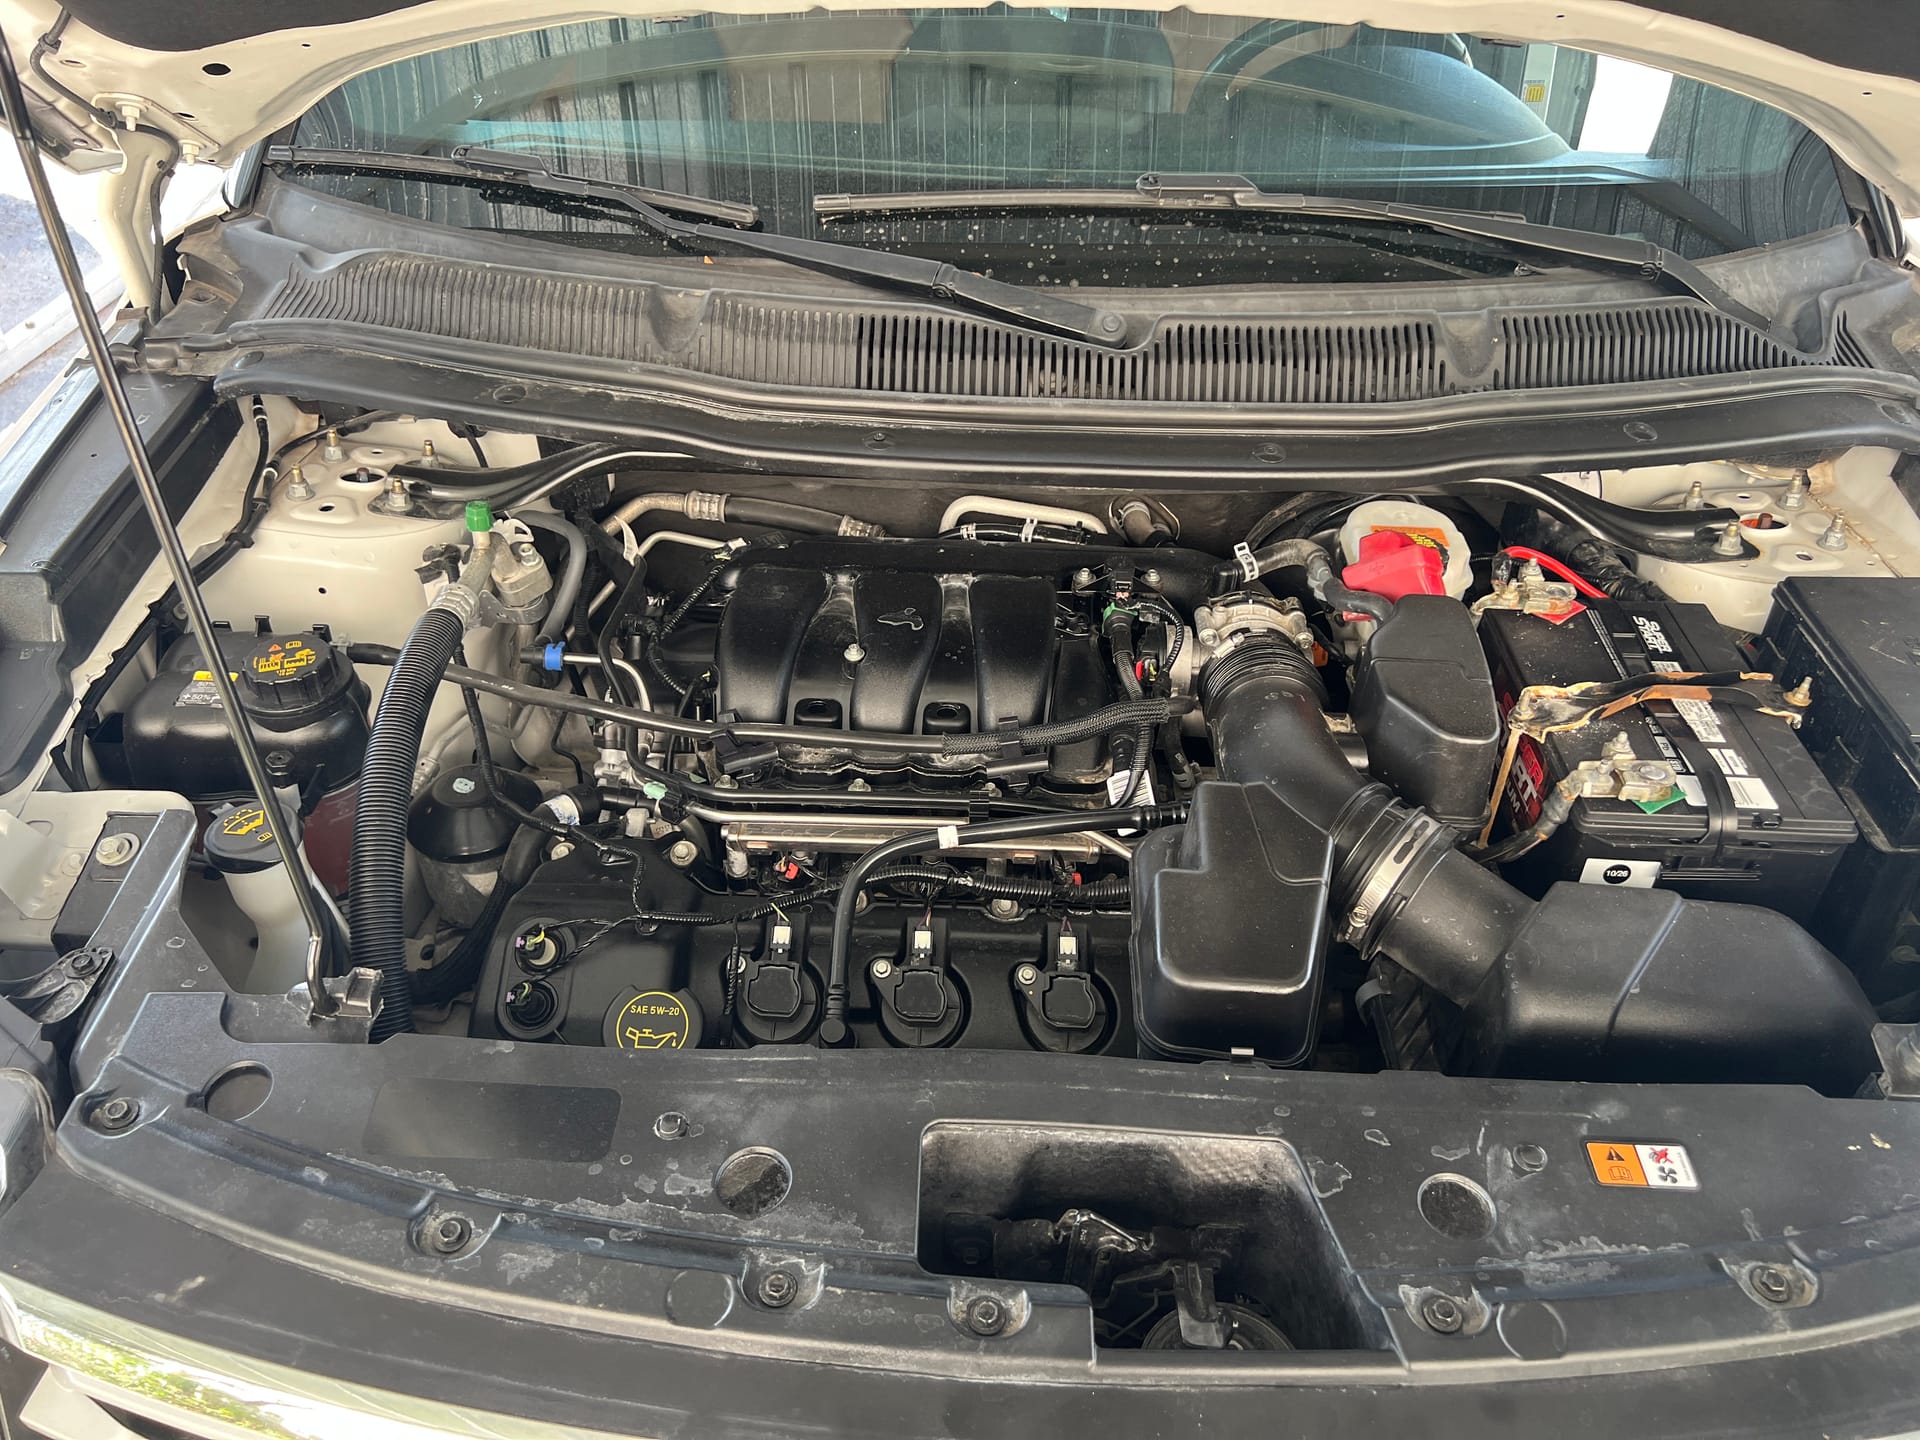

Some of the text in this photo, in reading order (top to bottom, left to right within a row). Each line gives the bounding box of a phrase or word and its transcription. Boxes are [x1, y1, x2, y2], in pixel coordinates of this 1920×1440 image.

[1632, 615, 1663, 654] START
[1648, 621, 1673, 653] SUPER
[630, 1005, 680, 1016] SAE 5W-20
